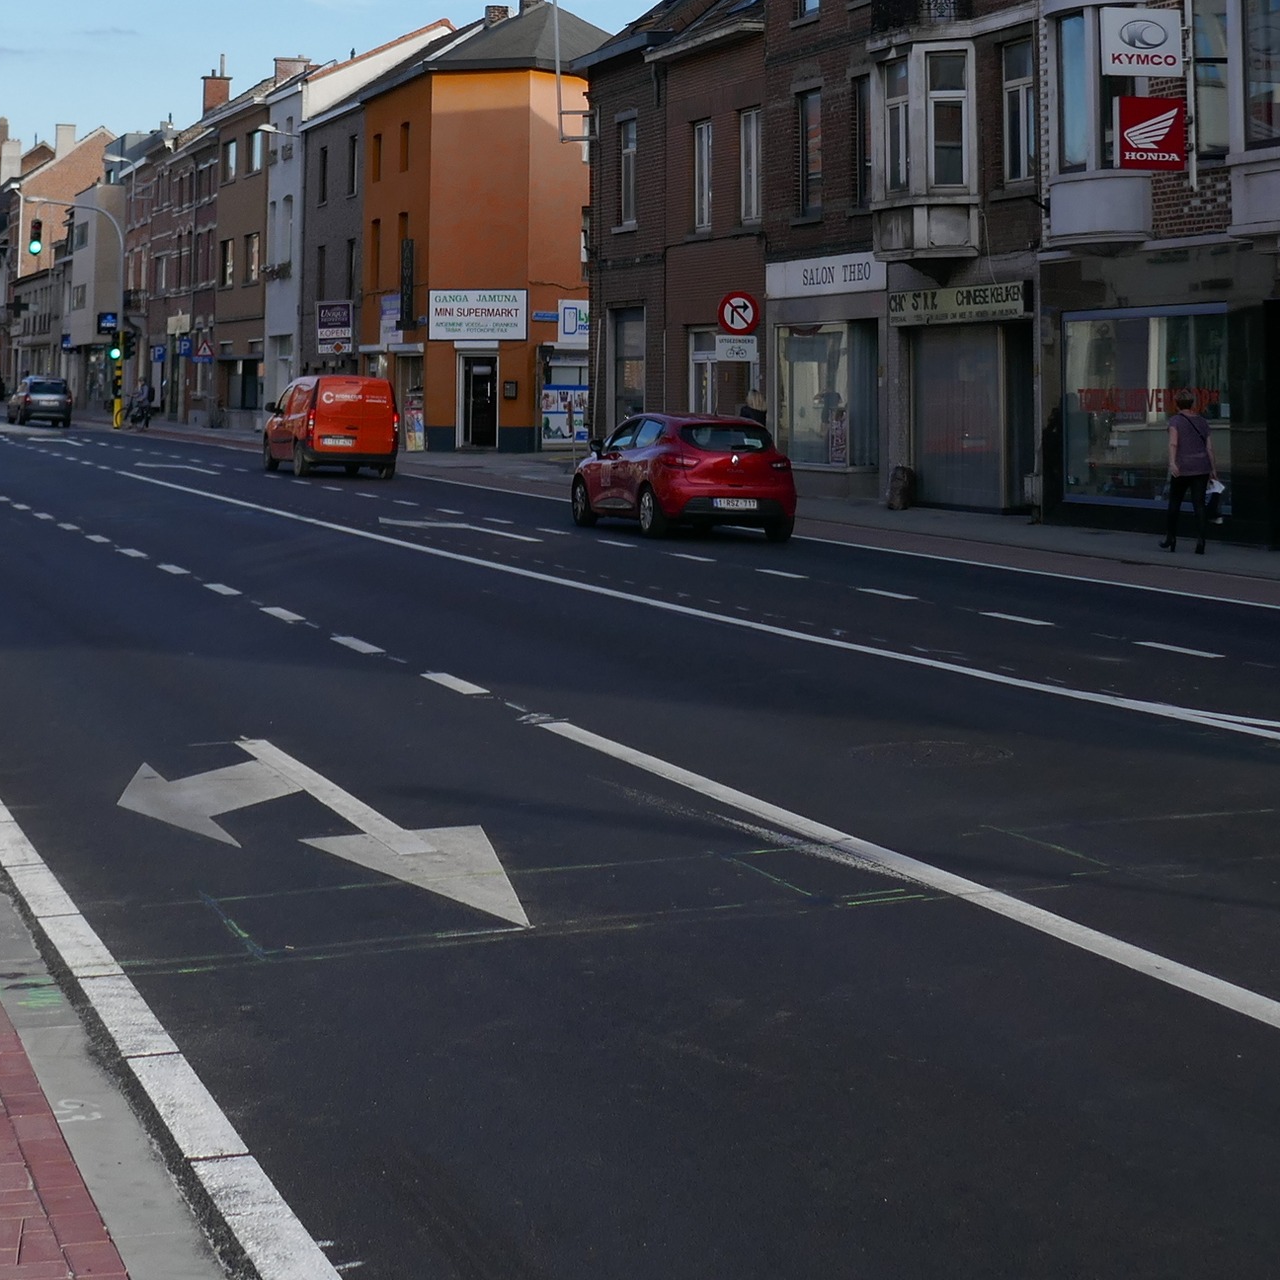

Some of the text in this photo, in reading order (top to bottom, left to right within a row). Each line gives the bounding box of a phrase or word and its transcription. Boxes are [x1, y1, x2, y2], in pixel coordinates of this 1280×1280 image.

[1111, 53, 1177, 66] KYMCO
[1124, 151, 1181, 161] HONDA
[802, 262, 872, 286] SALON THEO
[434, 294, 518, 303] GANGA JAMUNA
[956, 290, 989, 311] CHINESE
[434, 308, 520, 318] MINI SUPERMARKT
[155, 347, 163, 359] P
[181, 341, 190, 354] P
